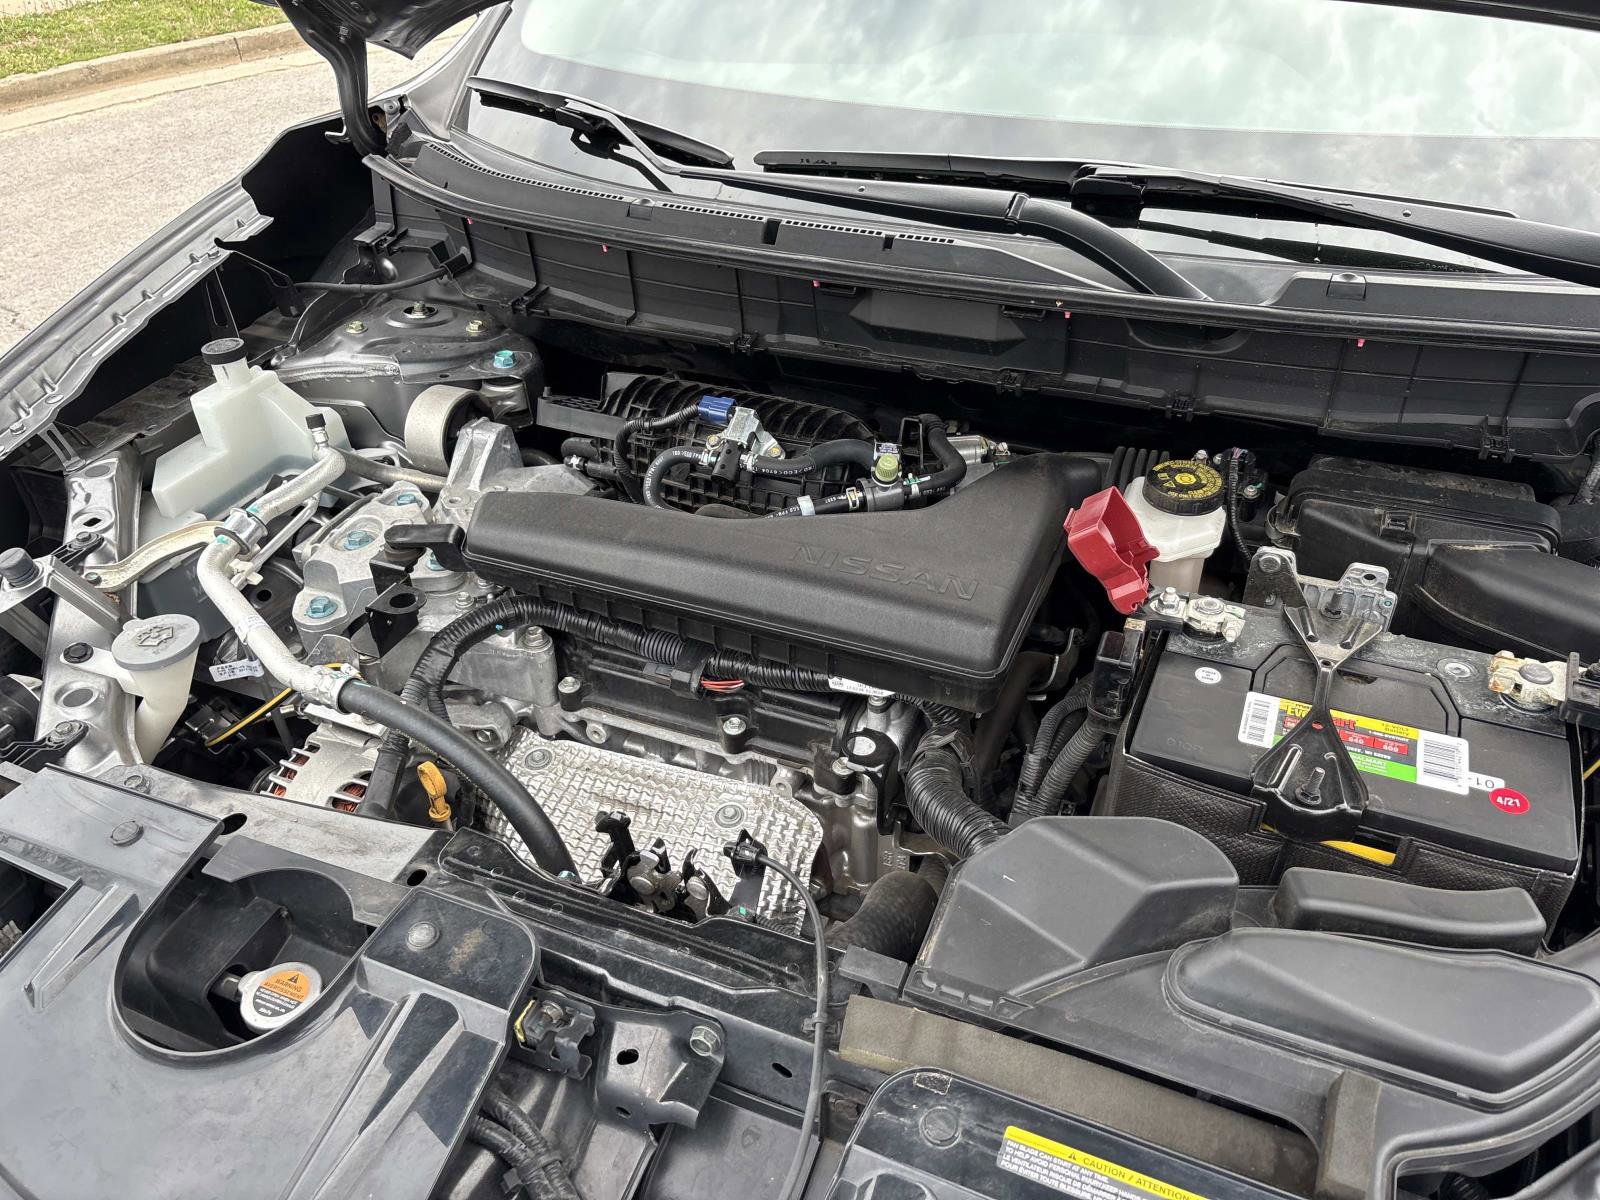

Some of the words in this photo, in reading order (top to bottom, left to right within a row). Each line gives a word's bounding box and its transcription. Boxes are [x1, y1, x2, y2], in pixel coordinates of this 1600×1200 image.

[786, 544, 980, 600] NISSAN
[1496, 796, 1520, 807] 4/21
[275, 978, 303, 992] WARNING
[1006, 1140, 1018, 1149] FAN
[1019, 1145, 1038, 1156] BLADE
[1038, 1152, 1052, 1161] CAN
[1052, 1157, 1071, 1168] START
[1080, 1167, 1093, 1176] ANY
[1014, 1150, 1029, 1159] HELP
[1029, 1156, 1048, 1167] AVOID
[1000, 1160, 1018, 1170] POUR
[1039, 1174, 1059, 1186] TOUTE
[1082, 1157, 1125, 1179] CAUTION
[1136, 1177, 1189, 1200] ATTENTION
